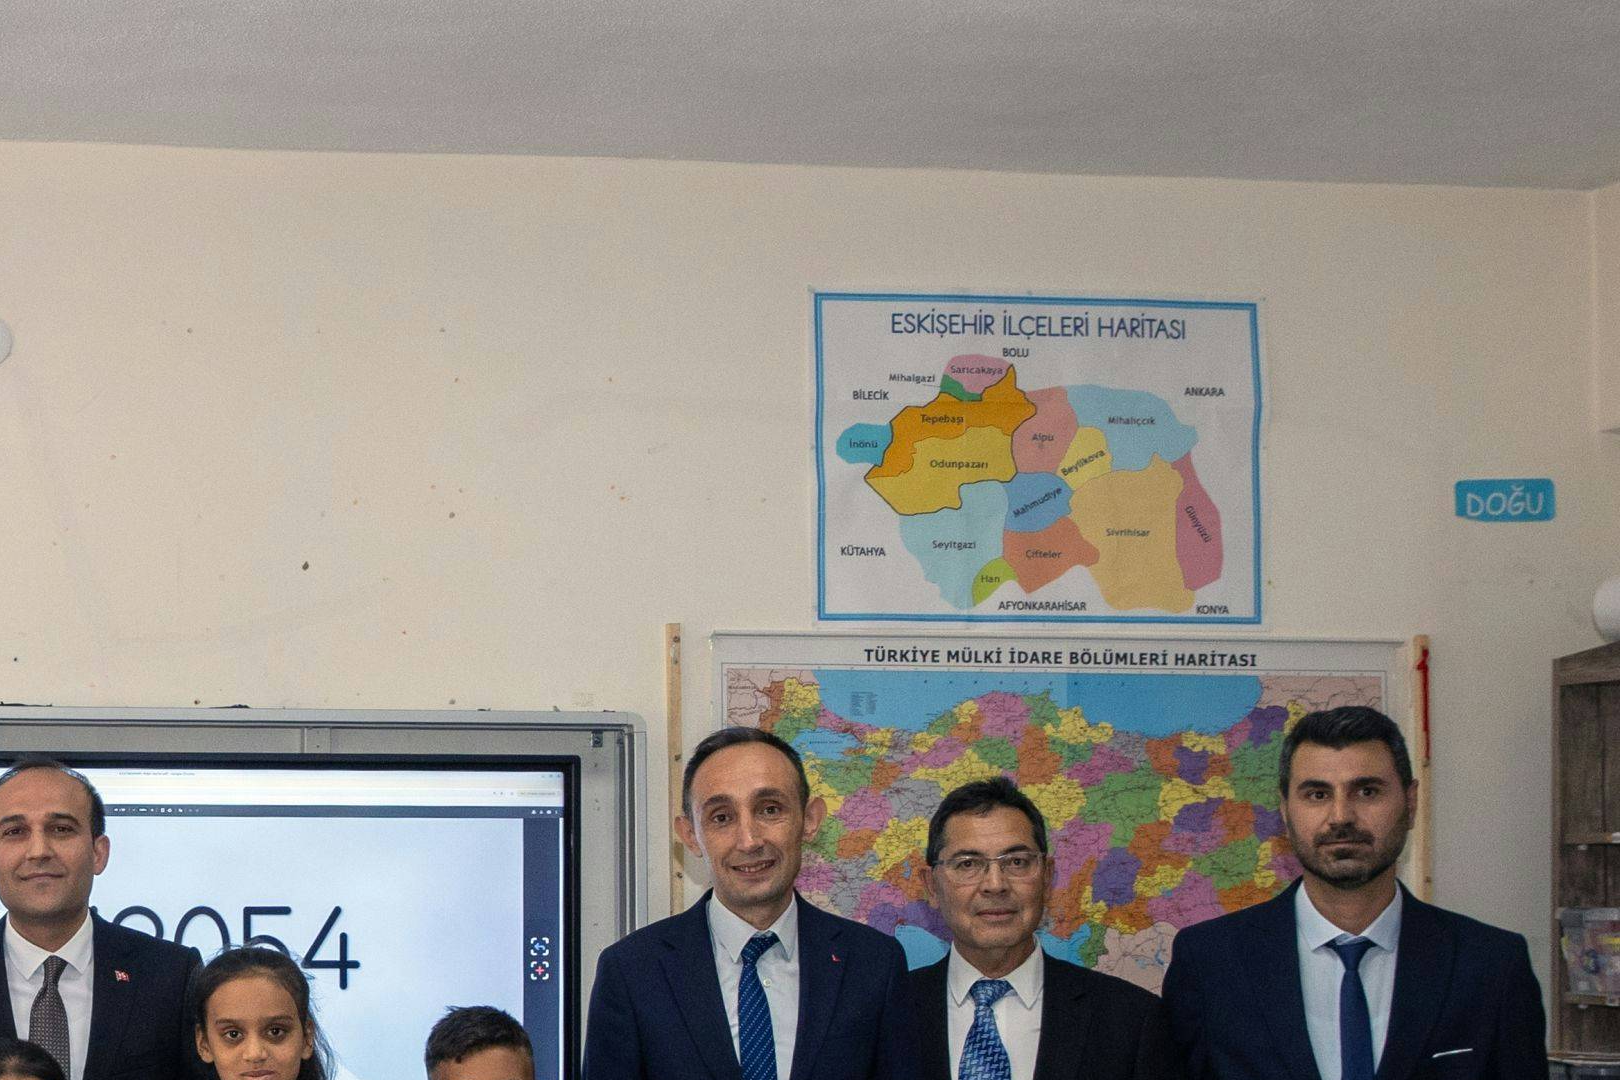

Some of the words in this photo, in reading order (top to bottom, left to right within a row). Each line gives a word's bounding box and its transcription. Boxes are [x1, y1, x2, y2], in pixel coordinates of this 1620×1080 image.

[891, 308, 995, 338] ESKİŞEHİR
[1003, 310, 1089, 340] İLÇELERİ
[1098, 313, 1186, 340] HARİTASI
[1002, 347, 1029, 358] BOLU
[852, 388, 890, 401] BİLECİK
[1184, 387, 1225, 397] ANKARA
[1032, 433, 1055, 443] Alpu
[1061, 449, 1105, 477] Beylikova
[1012, 486, 1063, 518] Mahmudiye
[1466, 484, 1544, 517] DOĞU
[840, 544, 886, 557] KÜTAHYA
[932, 540, 977, 551] Seyitgazi
[981, 574, 1000, 583] Han
[998, 599, 1086, 611] AFYONKARAHİSAR
[1196, 605, 1229, 615] KONYA
[864, 645, 940, 663] TÜRKİYE
[947, 646, 1002, 664] MÜLKİ
[1008, 647, 1063, 664] İDARE
[1069, 648, 1168, 666] BÖLÜMLERİ
[1174, 650, 1257, 667] HARİTASI
